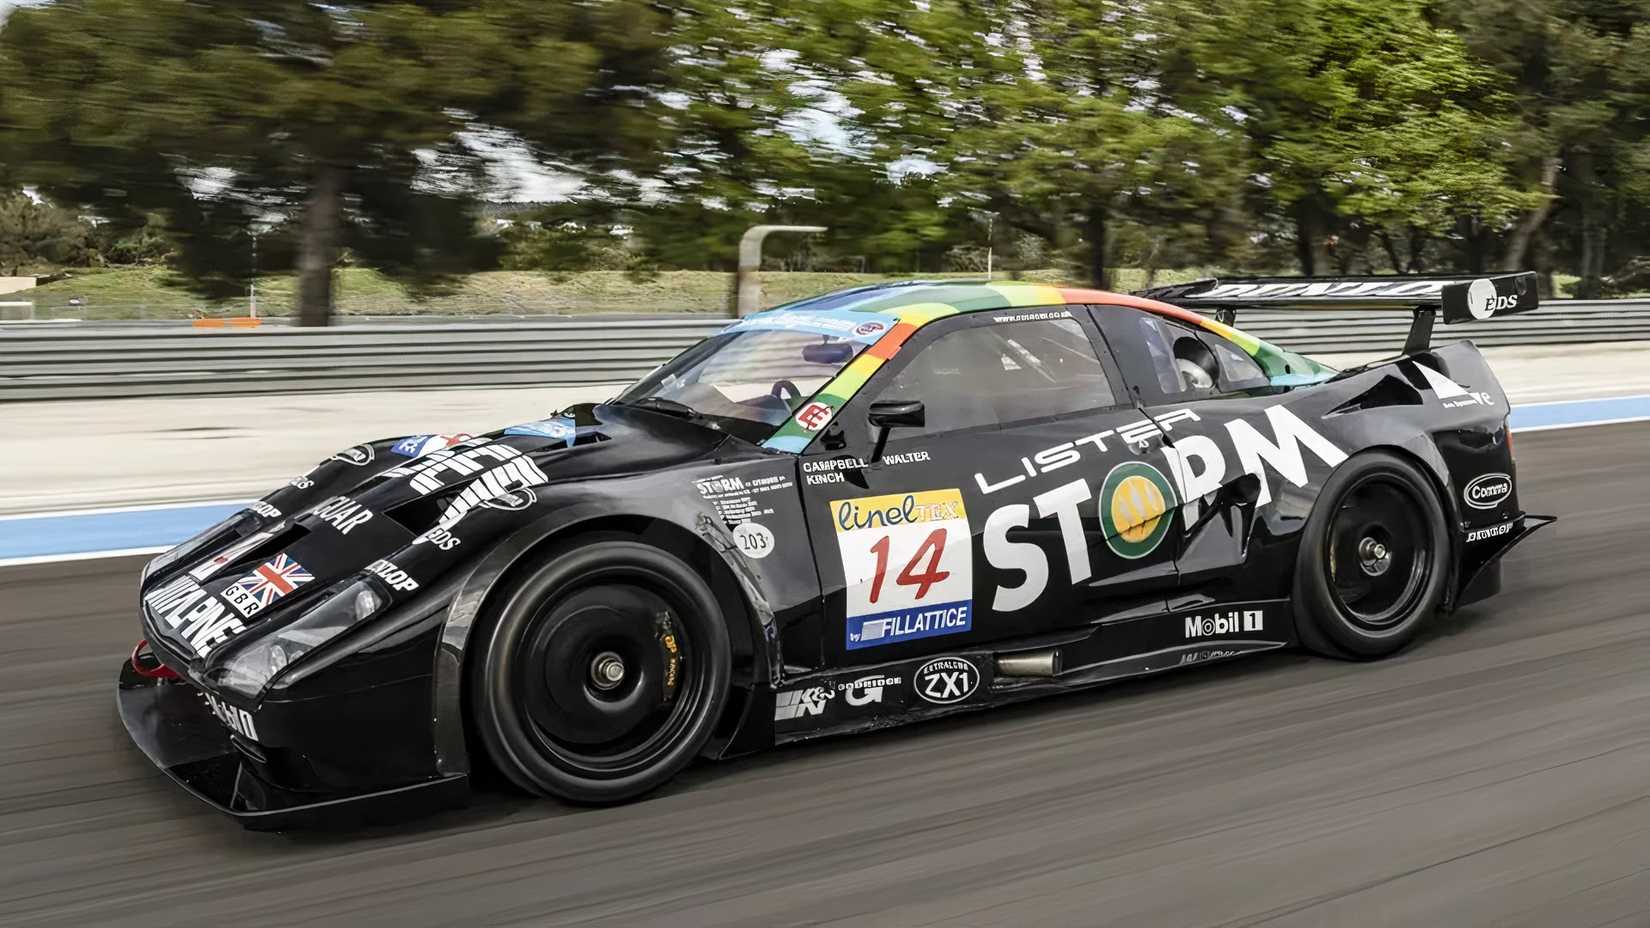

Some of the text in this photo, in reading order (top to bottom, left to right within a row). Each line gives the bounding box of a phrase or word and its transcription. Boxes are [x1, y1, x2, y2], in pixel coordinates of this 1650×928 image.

[803, 451, 931, 473] CAMPBELL WALTER
[974, 408, 1201, 494] LISTER
[806, 472, 845, 486] KINCH
[869, 528, 950, 604] 14
[882, 606, 968, 637] FILLATTICE
[1185, 611, 1240, 639] Mobil
[925, 671, 969, 698] ZX1
